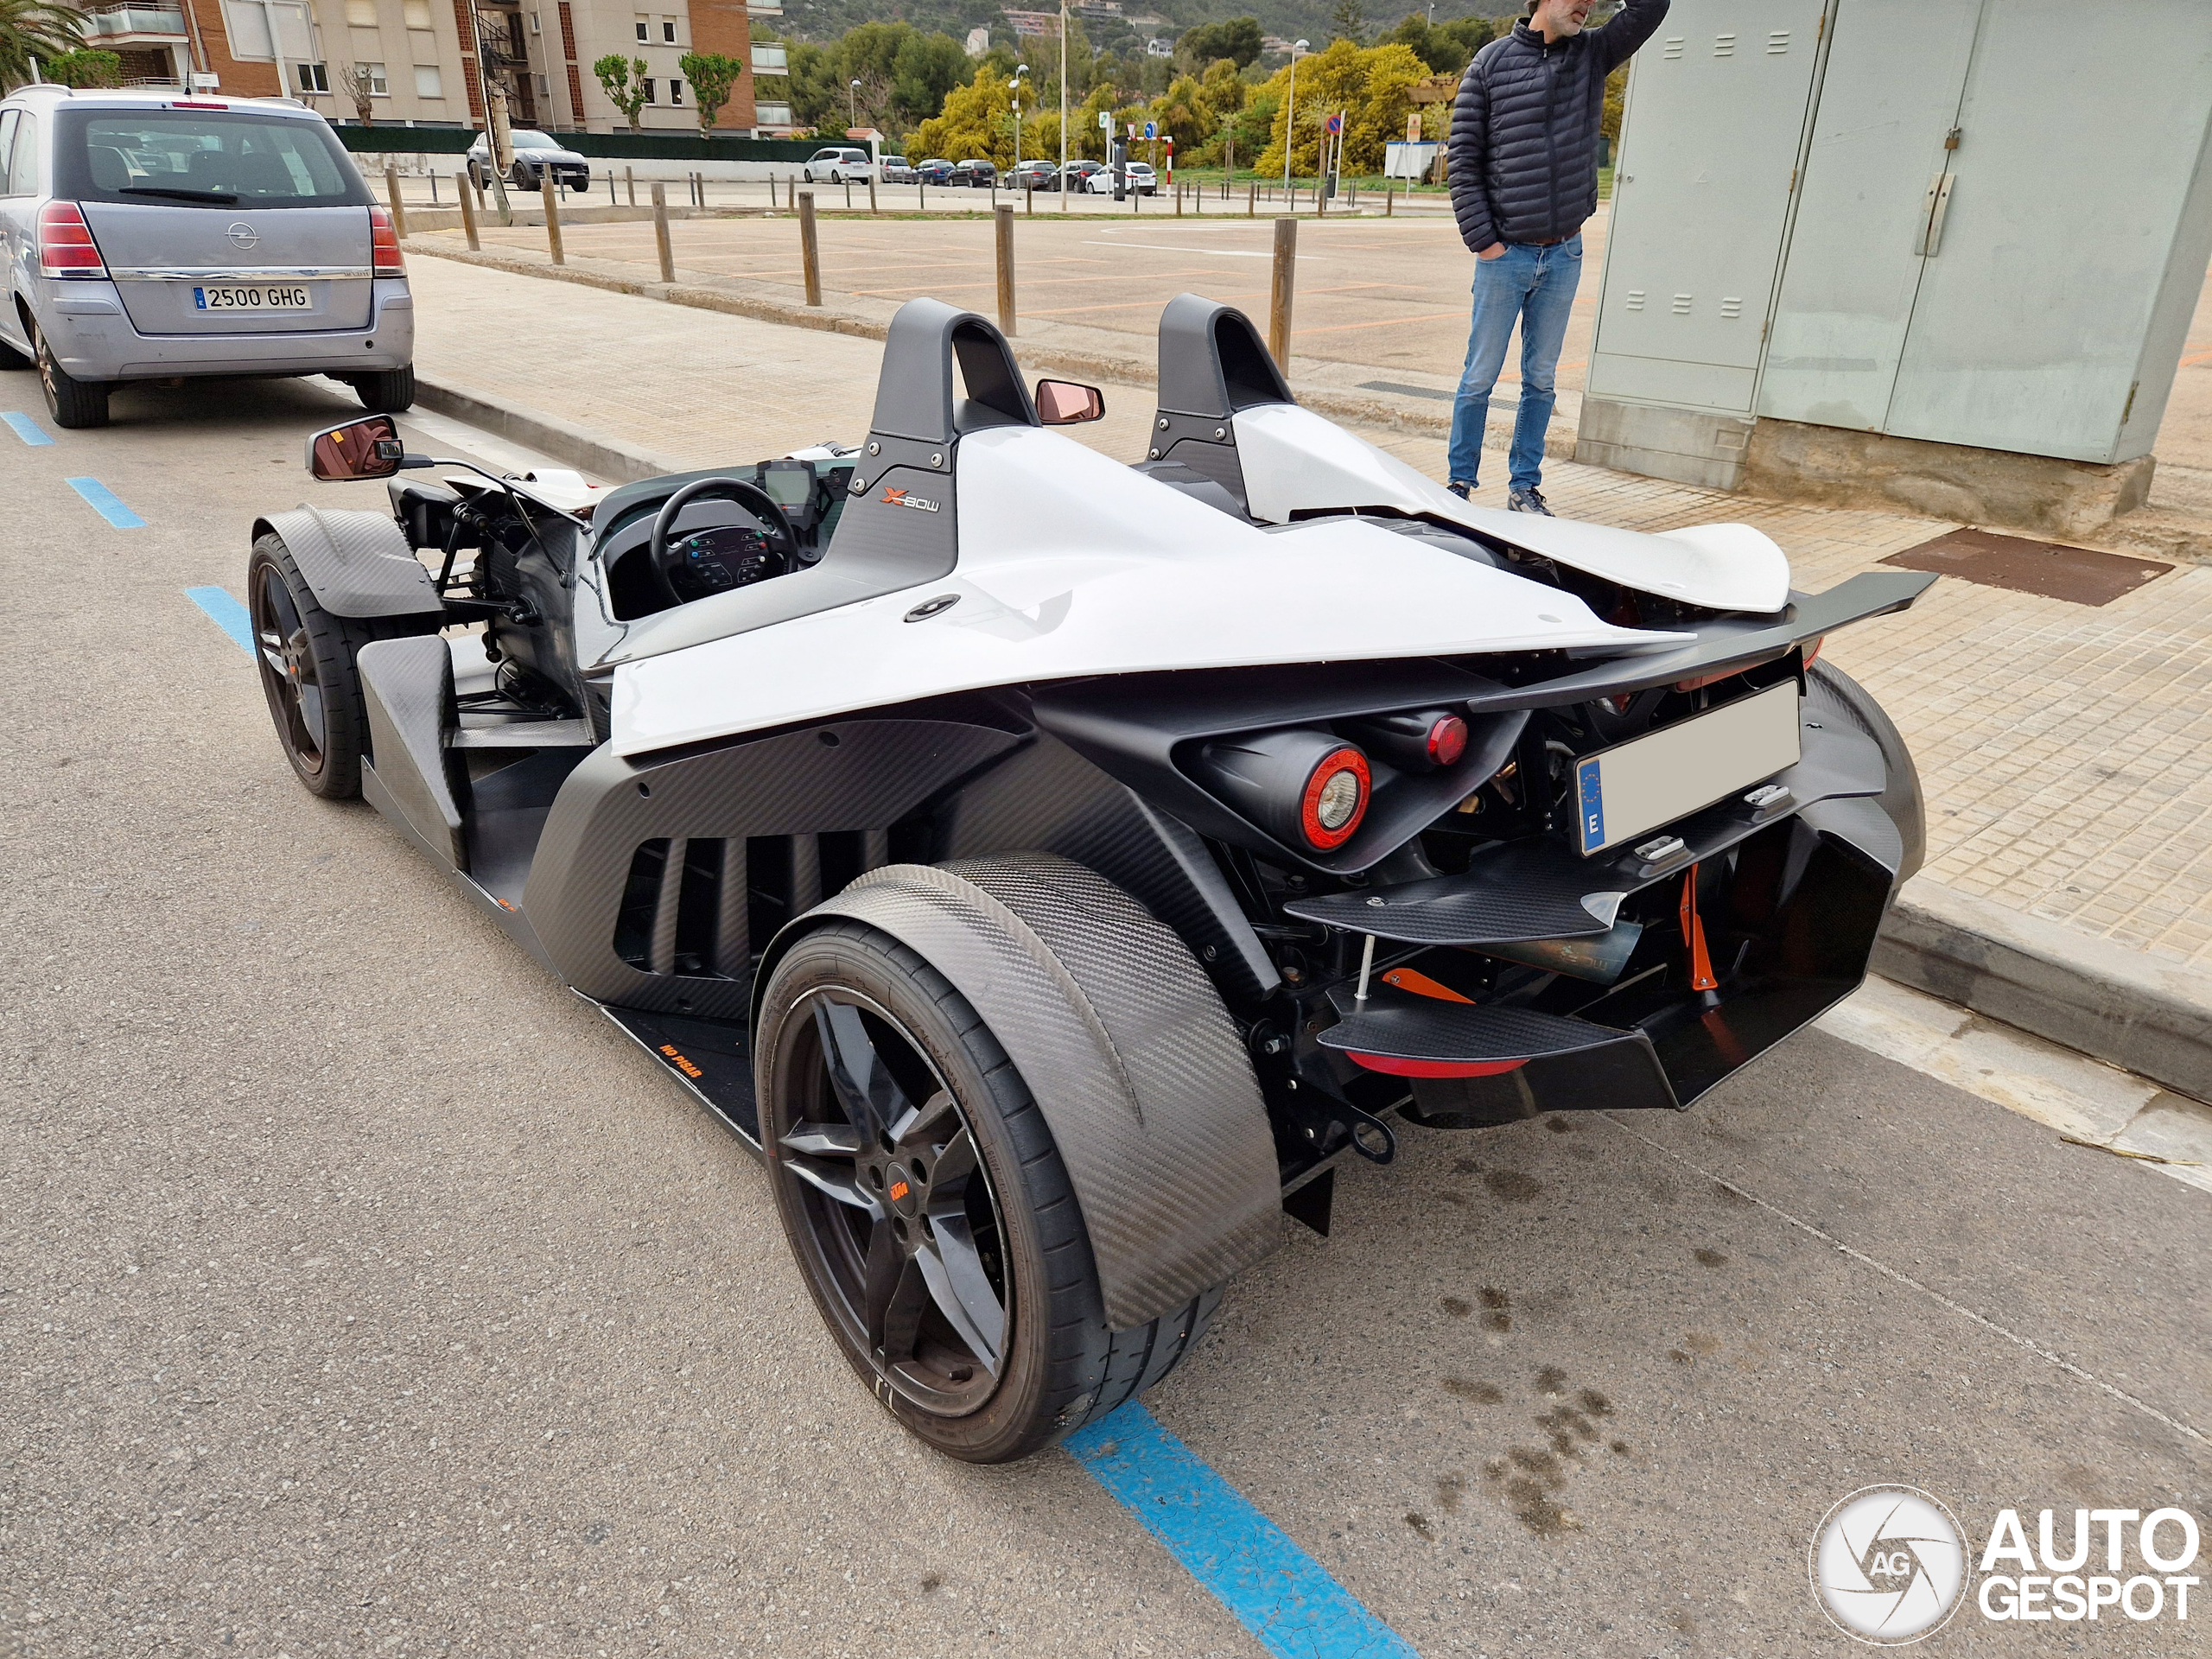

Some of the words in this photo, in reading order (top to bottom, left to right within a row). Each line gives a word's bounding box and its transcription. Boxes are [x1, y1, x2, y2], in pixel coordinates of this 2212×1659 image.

[208, 289, 260, 307] 2500
[267, 289, 306, 306] GHG
[880, 486, 940, 512] X-BOW
[1588, 813, 1599, 834] E
[659, 1045, 678, 1056] NO
[671, 1055, 702, 1078] PISAR
[890, 1181, 909, 1201] KTM
